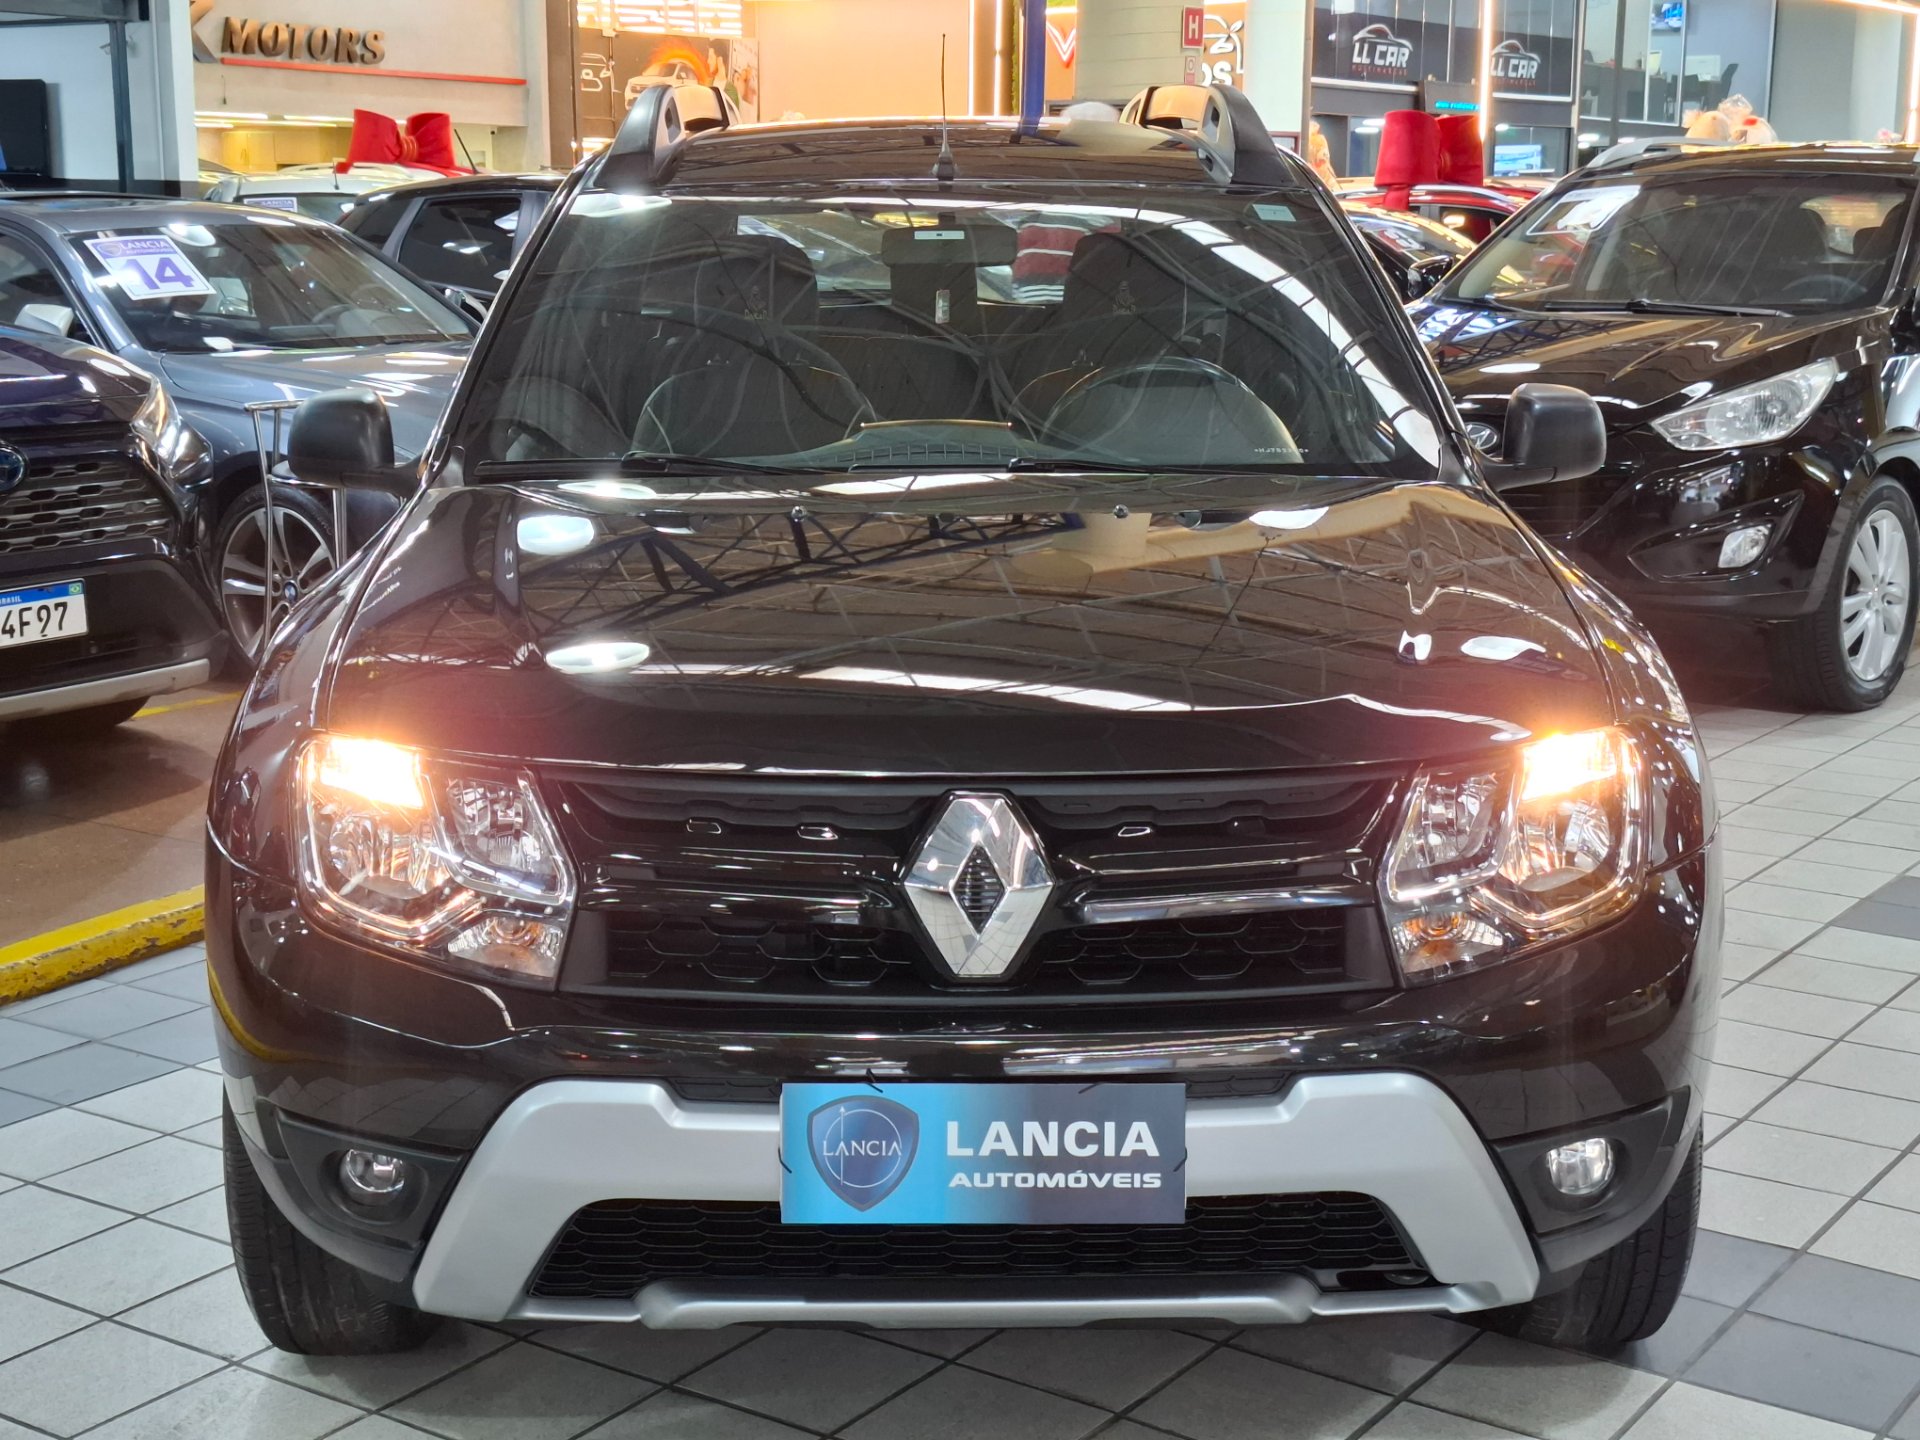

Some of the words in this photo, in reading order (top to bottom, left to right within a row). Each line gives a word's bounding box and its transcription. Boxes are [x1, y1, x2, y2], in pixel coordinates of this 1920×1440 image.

[1188, 14, 1200, 40] H
[221, 16, 386, 65] MOTORS
[1352, 42, 1371, 65] LL
[1374, 45, 1410, 68] CAR
[1508, 59, 1539, 80] CAR
[120, 240, 169, 250] LANCIA
[122, 256, 195, 291] 14
[1, 601, 68, 639] 4F97
[822, 1140, 902, 1157] LANCIA
[946, 1120, 1161, 1158] LANCIA
[948, 1169, 1162, 1189] AUTOMÓVEIS
